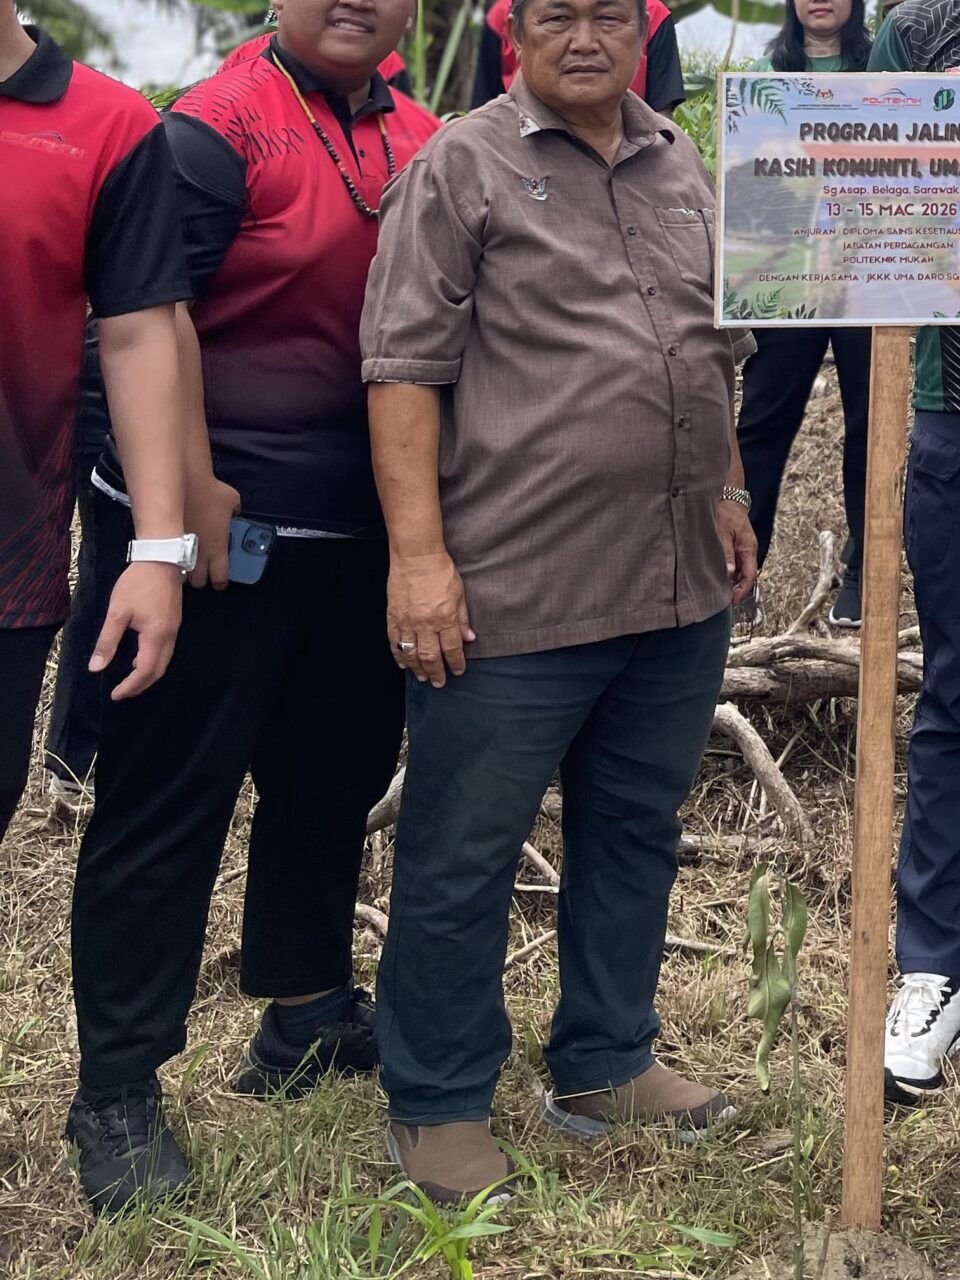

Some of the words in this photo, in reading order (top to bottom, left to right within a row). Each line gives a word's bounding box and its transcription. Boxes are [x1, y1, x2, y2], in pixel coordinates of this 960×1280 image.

[799, 122, 899, 142] PROGRAM
[753, 158, 816, 177] KASIH
[823, 158, 922, 178] KOMUNITI,
[872, 185, 912, 197] Belaga,
[913, 185, 959, 195] Sarawak
[826, 203, 841, 216] 13
[859, 203, 874, 216] 15
[879, 203, 915, 216] MAC
[921, 203, 958, 216] 2026
[794, 228, 836, 237] ANJURAN
[843, 242, 882, 251] JABATAN
[843, 256, 897, 264] POLITEKNIK
[758, 274, 800, 282] DENGAN
[801, 273, 859, 283] KERJASAMA
[866, 273, 892, 283] JKKK
[893, 273, 915, 281] UMA
